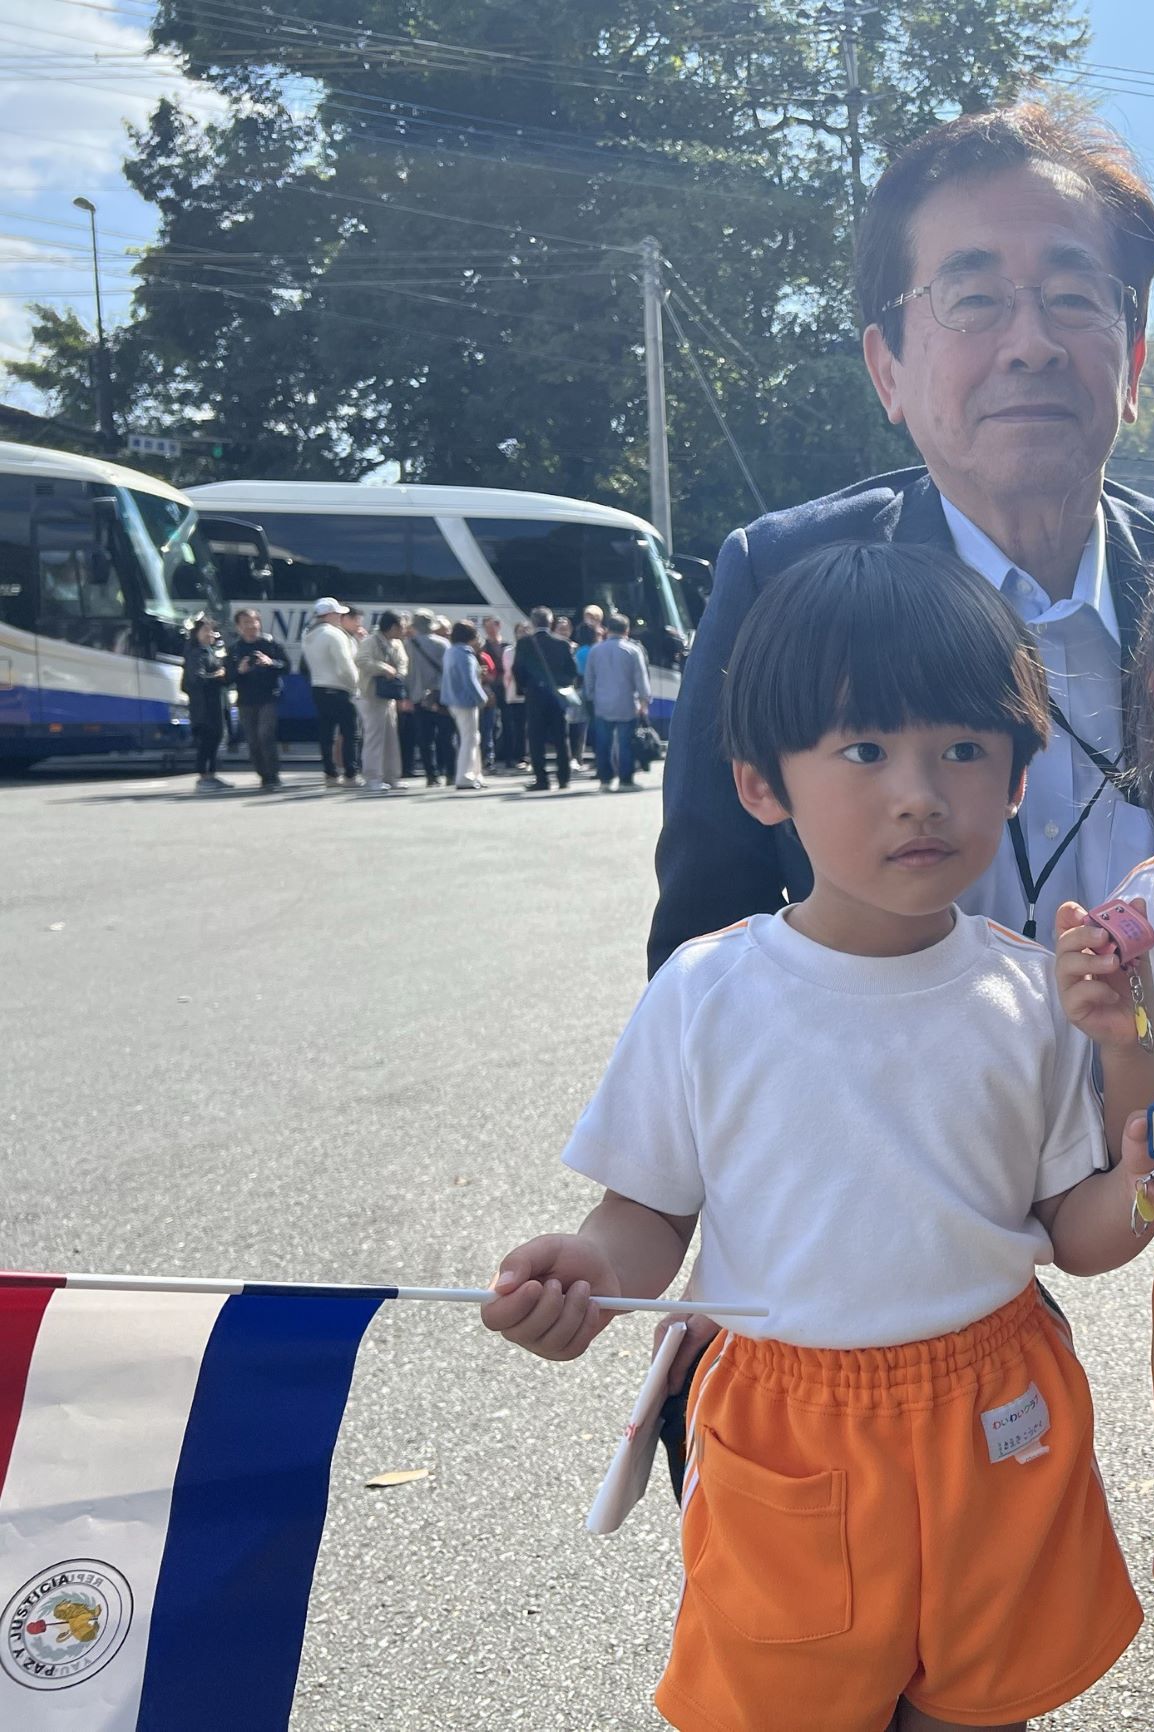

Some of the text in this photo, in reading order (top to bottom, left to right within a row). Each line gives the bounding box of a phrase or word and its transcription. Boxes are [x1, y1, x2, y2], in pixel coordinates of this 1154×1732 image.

[10, 1574, 69, 1677] PAZ Y JUSTICIA
